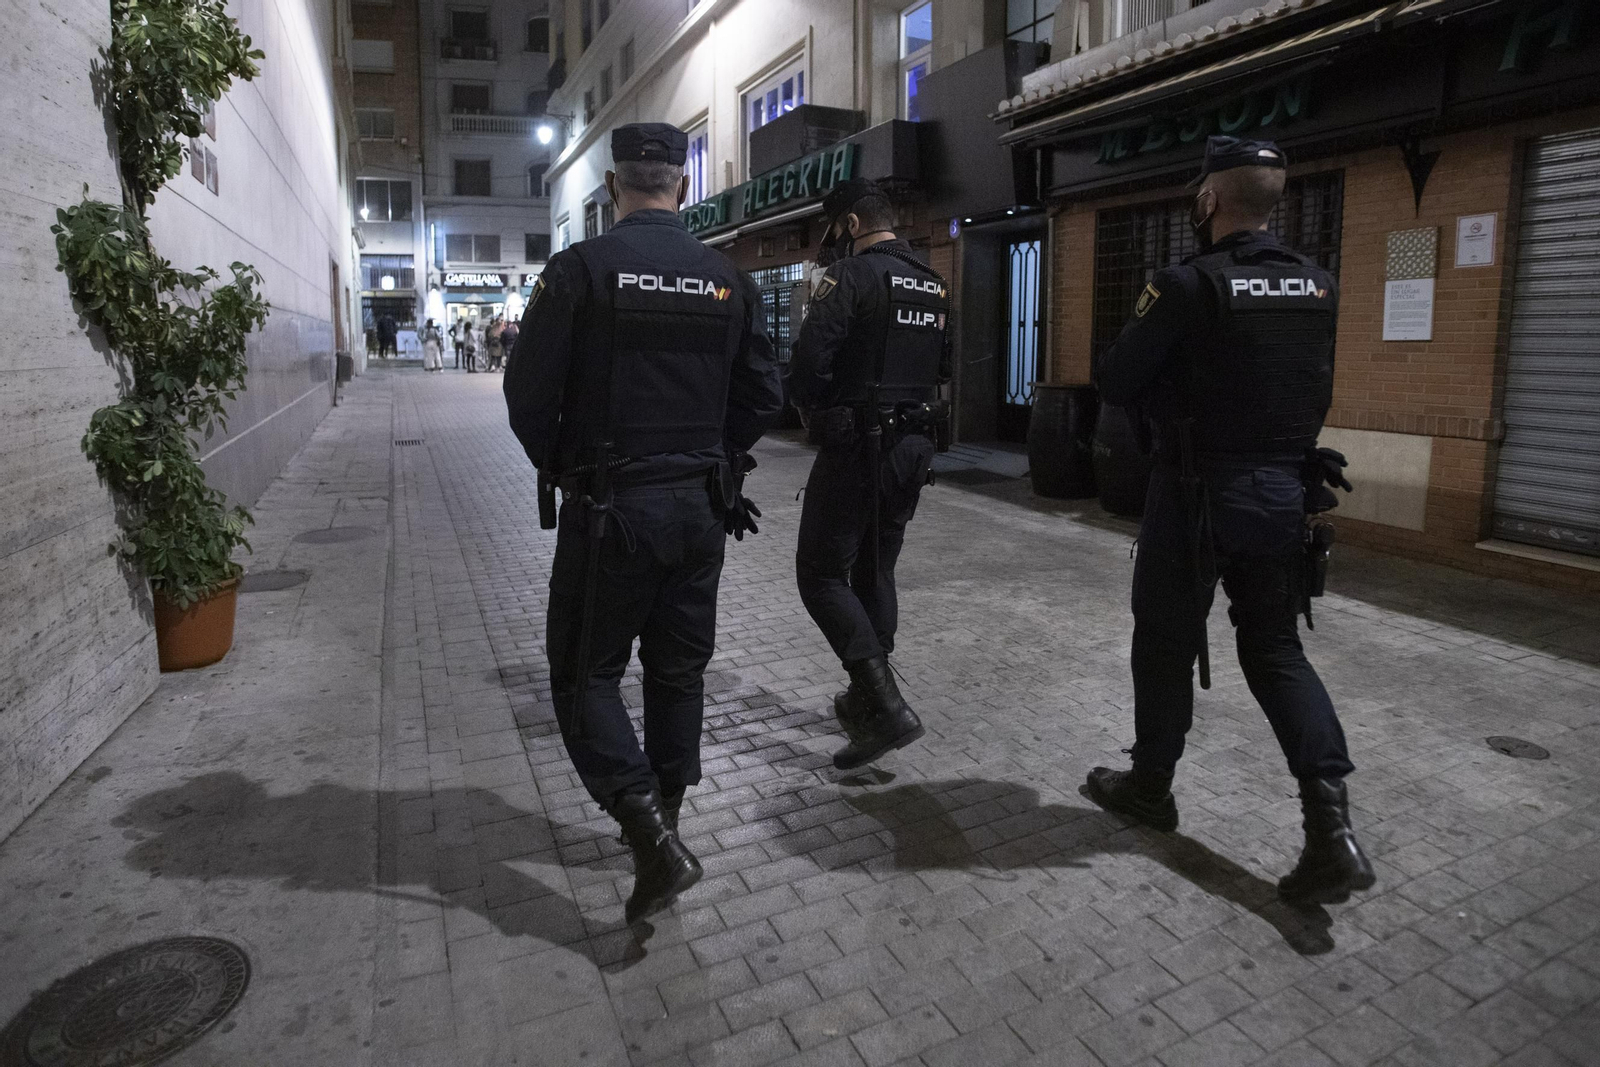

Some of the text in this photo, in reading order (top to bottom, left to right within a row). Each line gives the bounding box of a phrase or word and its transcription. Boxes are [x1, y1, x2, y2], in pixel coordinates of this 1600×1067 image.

[742, 142, 851, 218] ALEGRIA
[445, 273, 502, 284] CASTELLANA
[618, 273, 719, 297] POLICIA
[892, 276, 942, 296] POLICIA
[1230, 278, 1318, 297] POLICIA
[897, 309, 937, 328] U.I.P.
